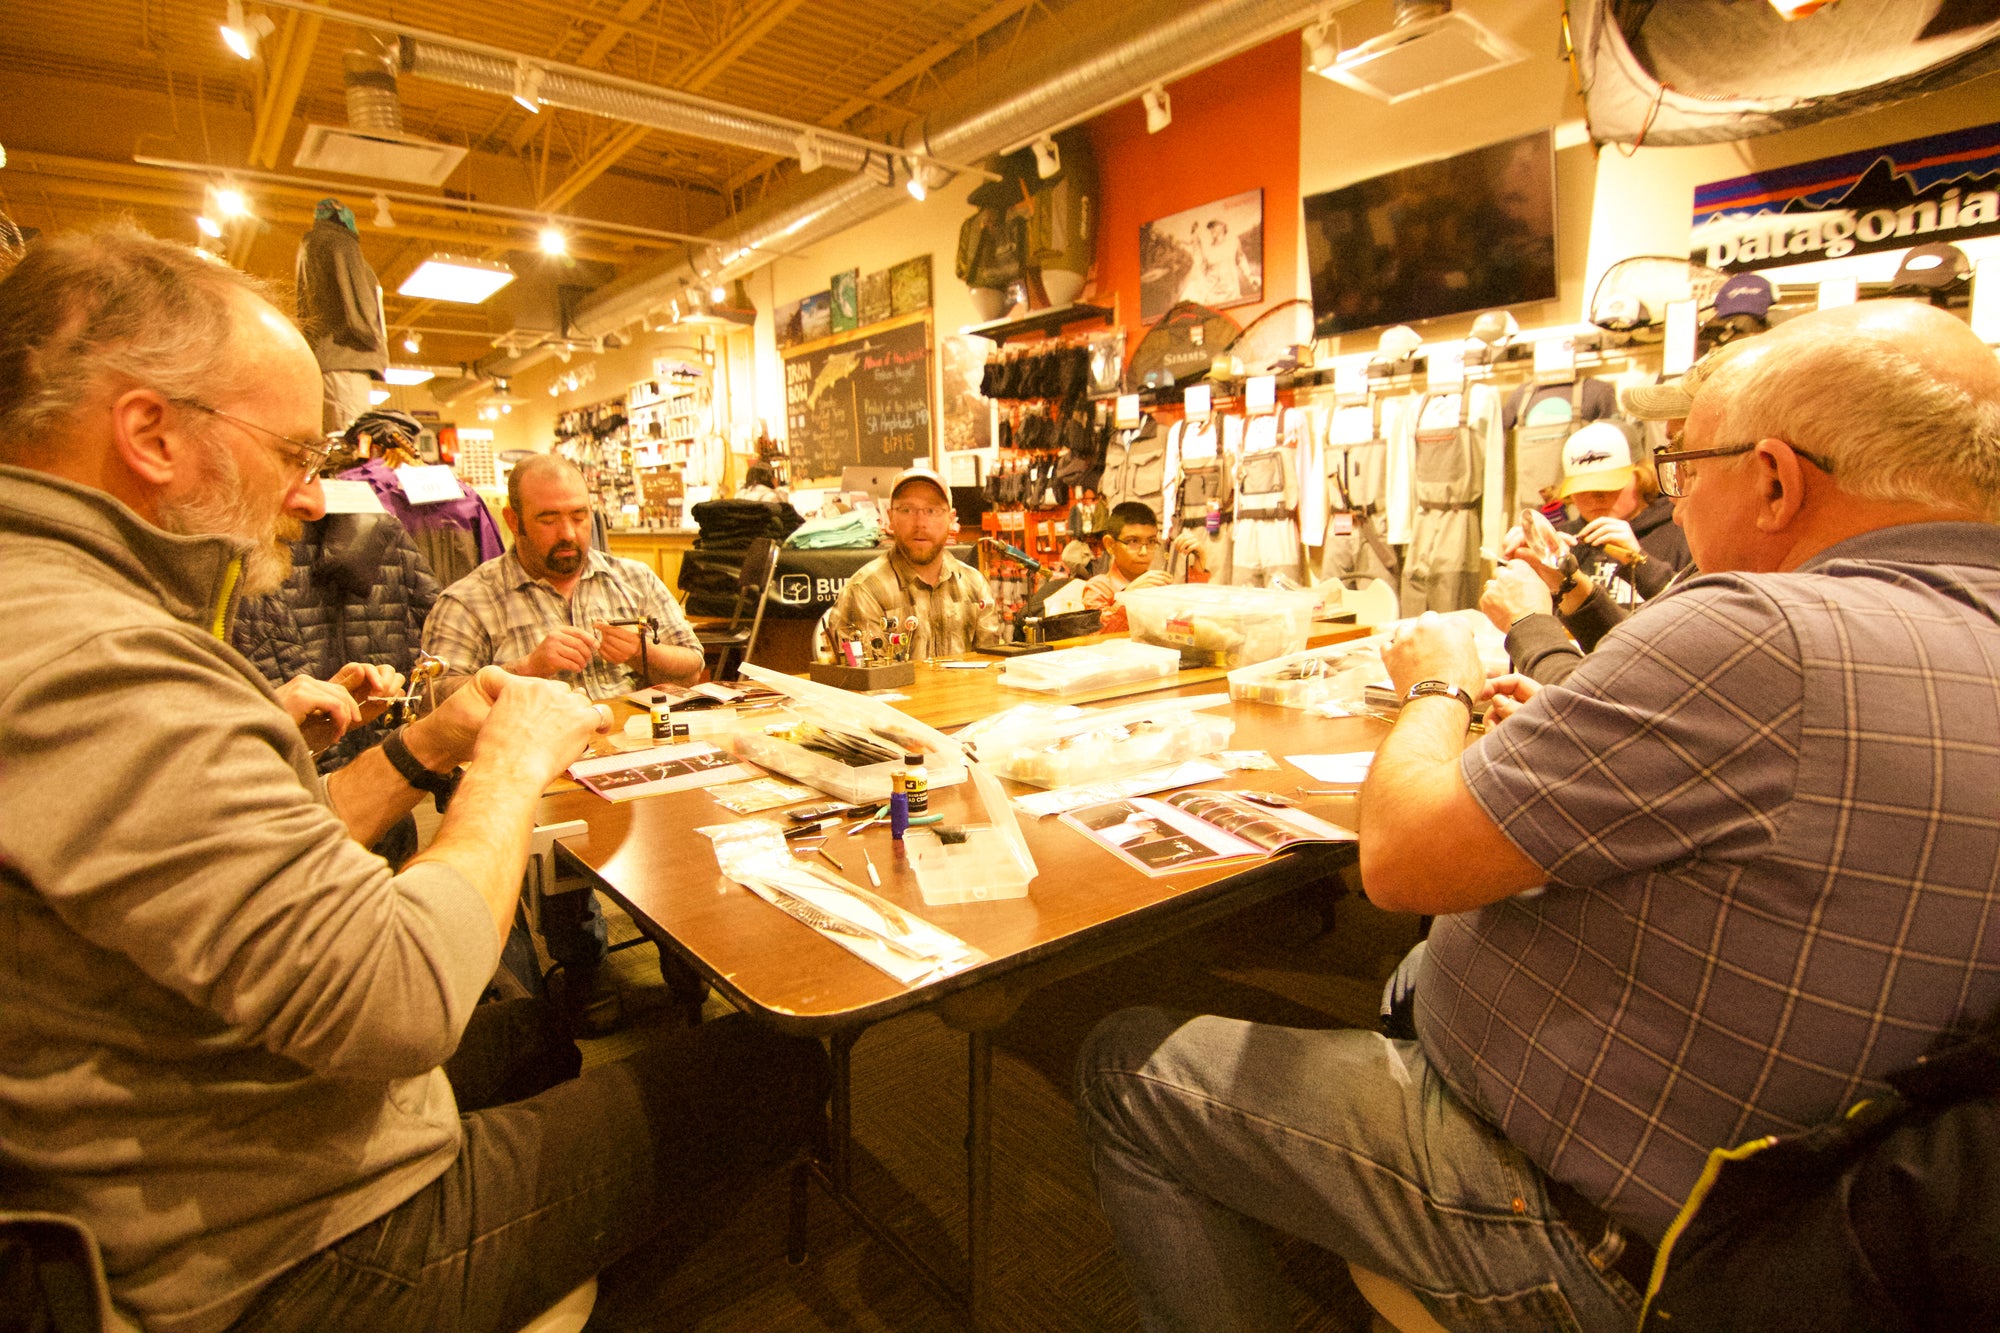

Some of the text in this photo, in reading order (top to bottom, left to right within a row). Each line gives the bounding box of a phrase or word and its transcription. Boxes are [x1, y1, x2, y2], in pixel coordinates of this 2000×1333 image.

[1705, 187, 1999, 267] patagonia
[1163, 350, 1208, 367] SIMMS
[817, 594, 838, 602] OUT
